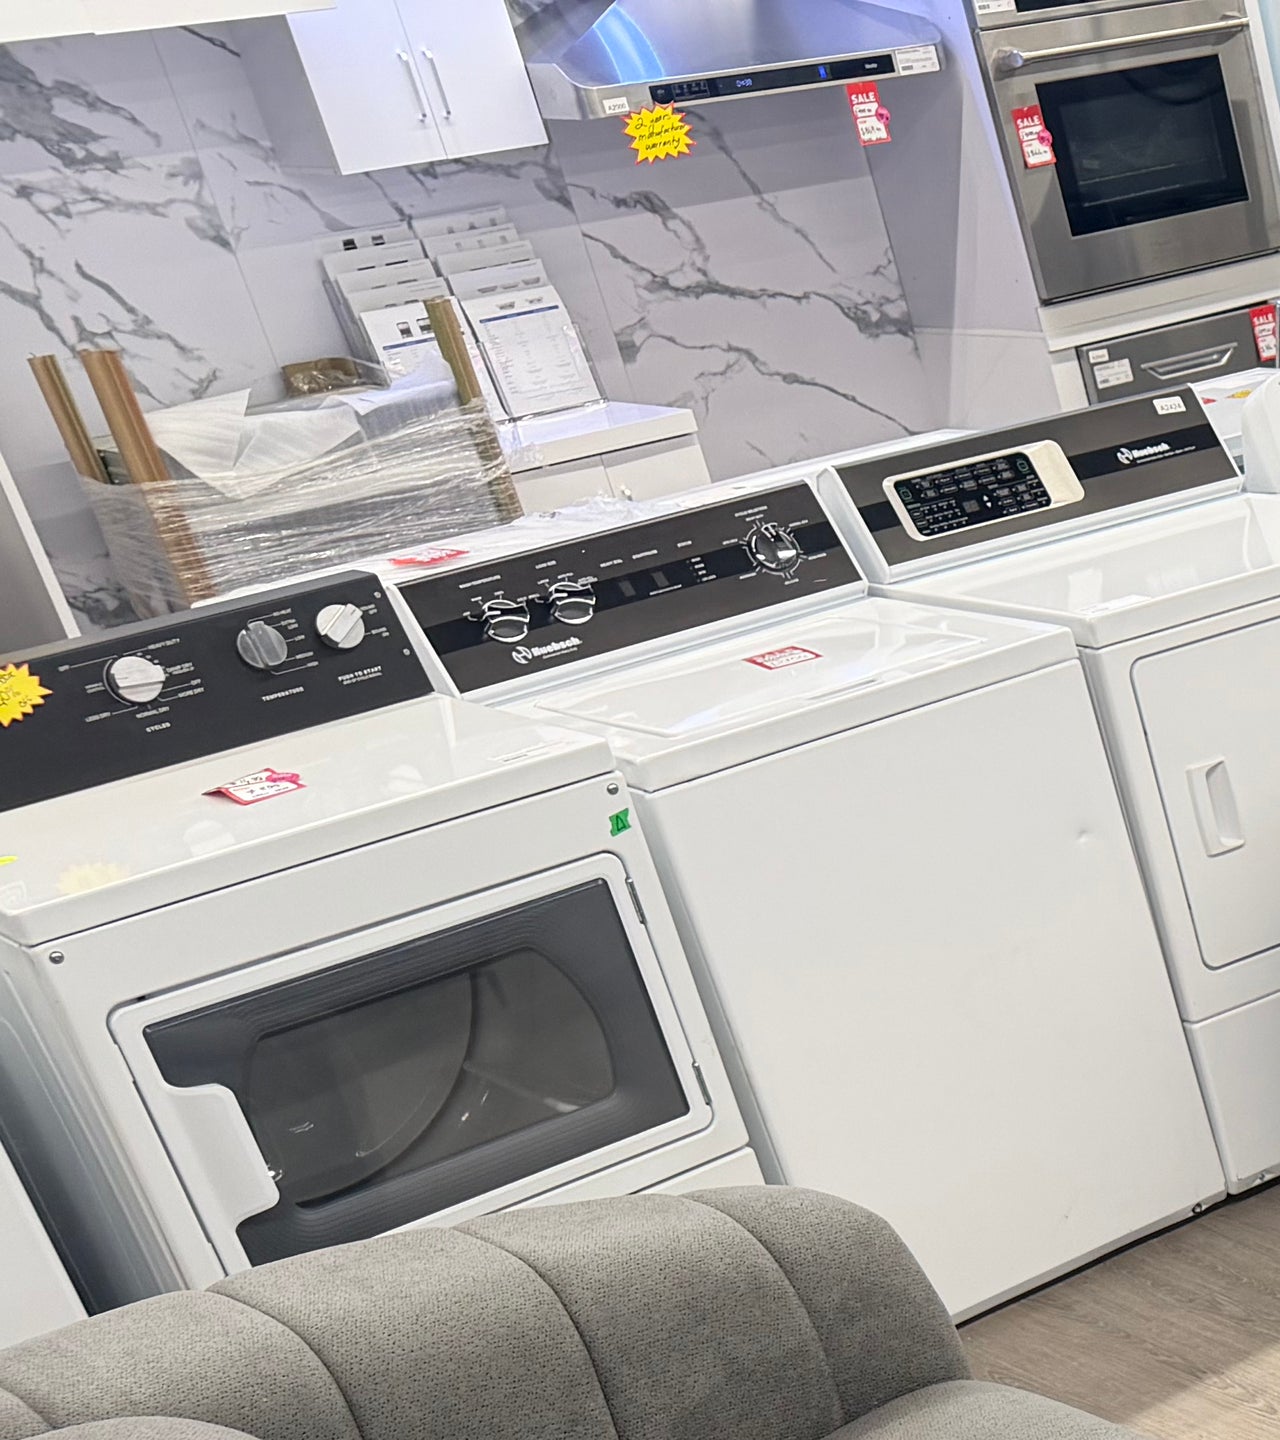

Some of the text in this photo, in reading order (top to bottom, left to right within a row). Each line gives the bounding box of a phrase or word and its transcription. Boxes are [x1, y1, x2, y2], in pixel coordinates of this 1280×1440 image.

[851, 92, 876, 104] SALE
[1017, 115, 1040, 128] SALE
[1253, 313, 1273, 325] SALE
[531, 636, 580, 657] Huebsch
[338, 672, 354, 681] PUSH
[364, 666, 382, 675] START
[262, 686, 304, 702] TEMPERATURE
[146, 722, 171, 732] CYCLES
